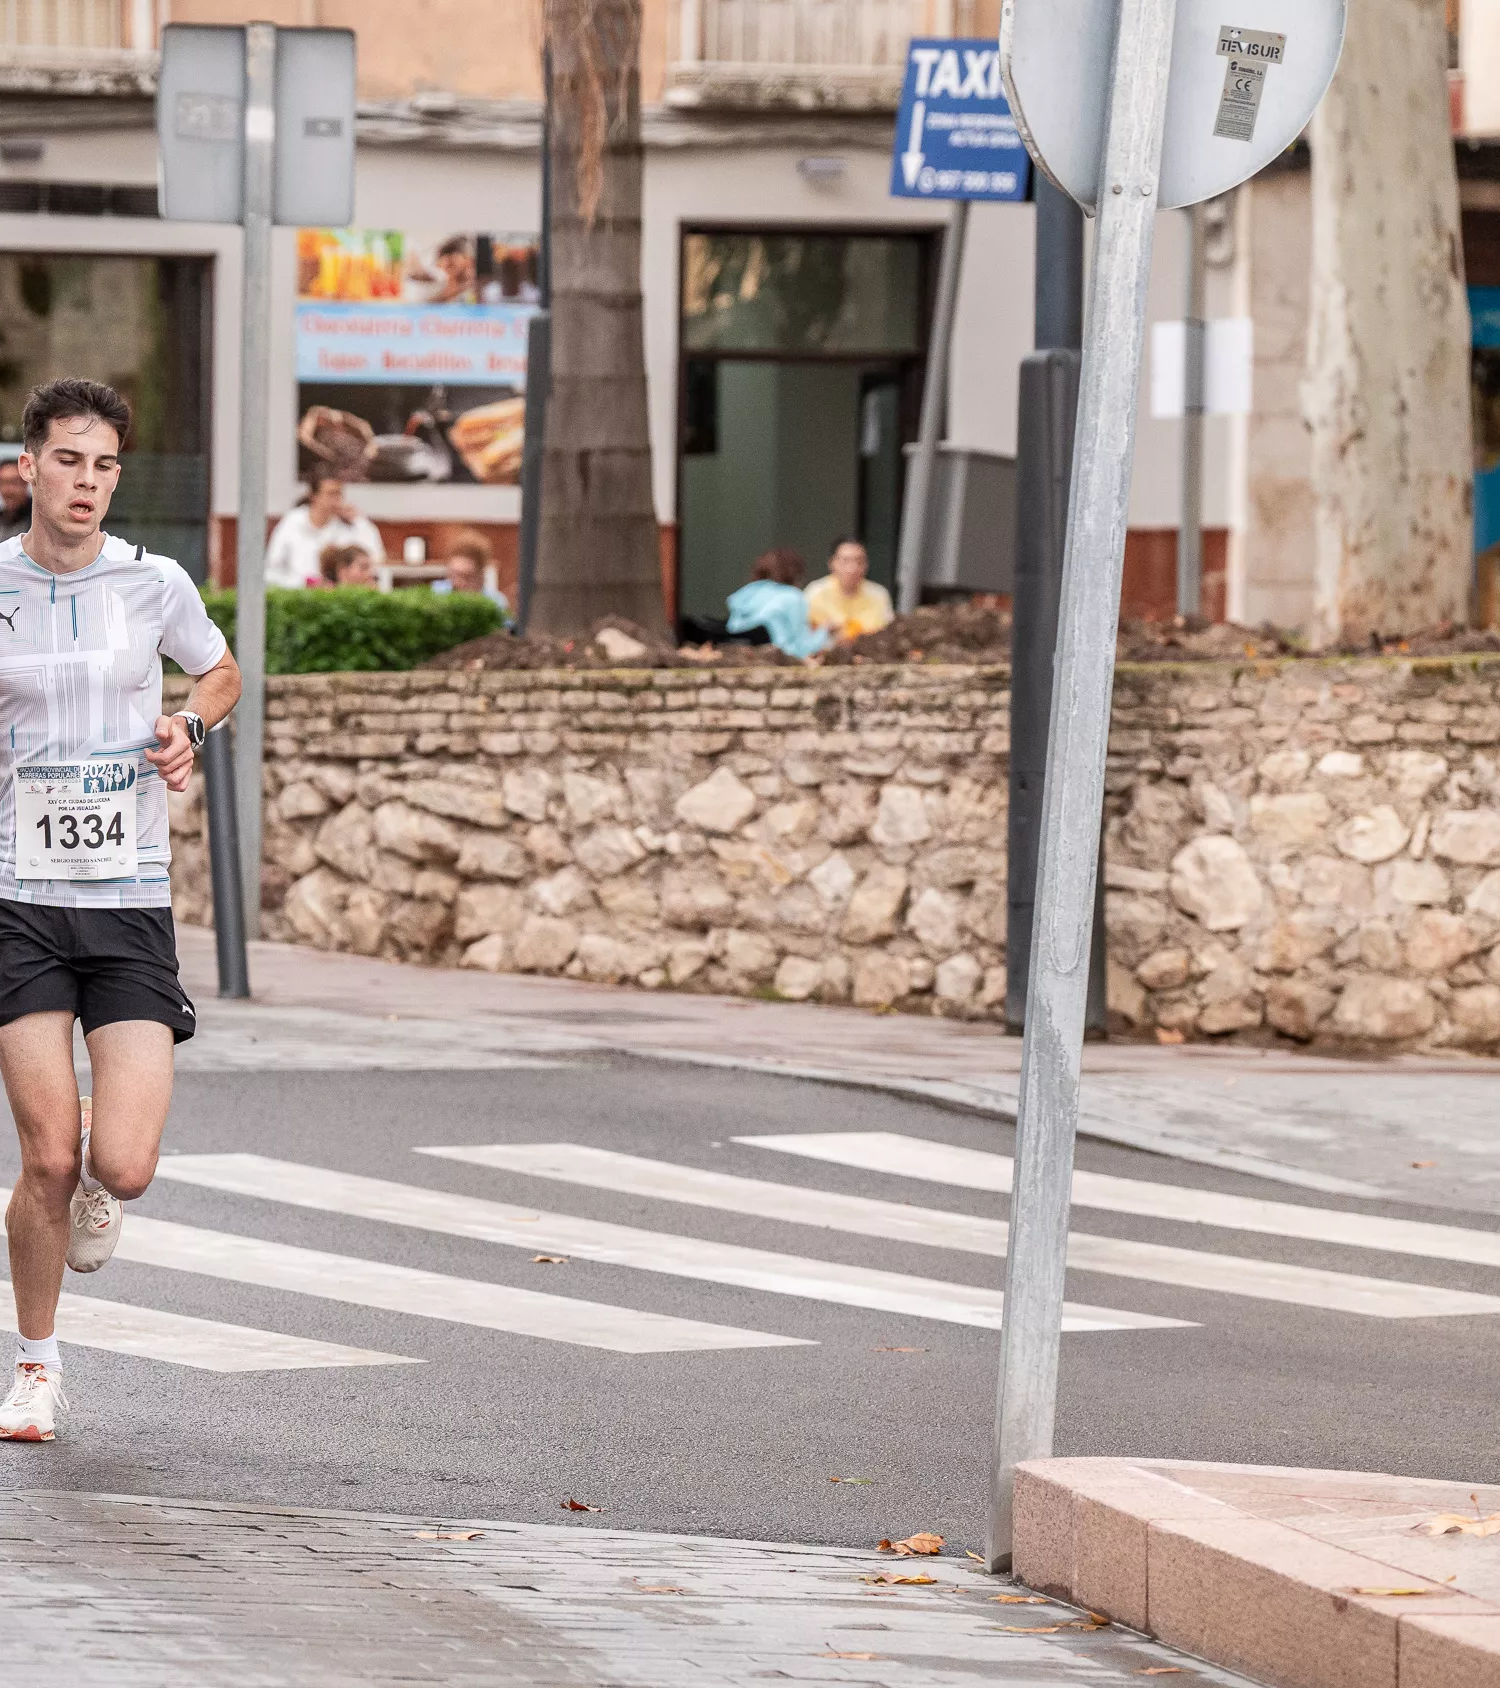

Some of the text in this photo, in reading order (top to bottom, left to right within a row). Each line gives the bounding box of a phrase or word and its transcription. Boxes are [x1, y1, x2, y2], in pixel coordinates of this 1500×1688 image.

[1220, 39, 1280, 59] TEVISUR
[912, 49, 1006, 99] TAXI
[1236, 79, 1252, 91] CE
[41, 766, 73, 774] PROVINCIAL
[82, 764, 114, 779] 2024
[36, 811, 125, 849] 1334
